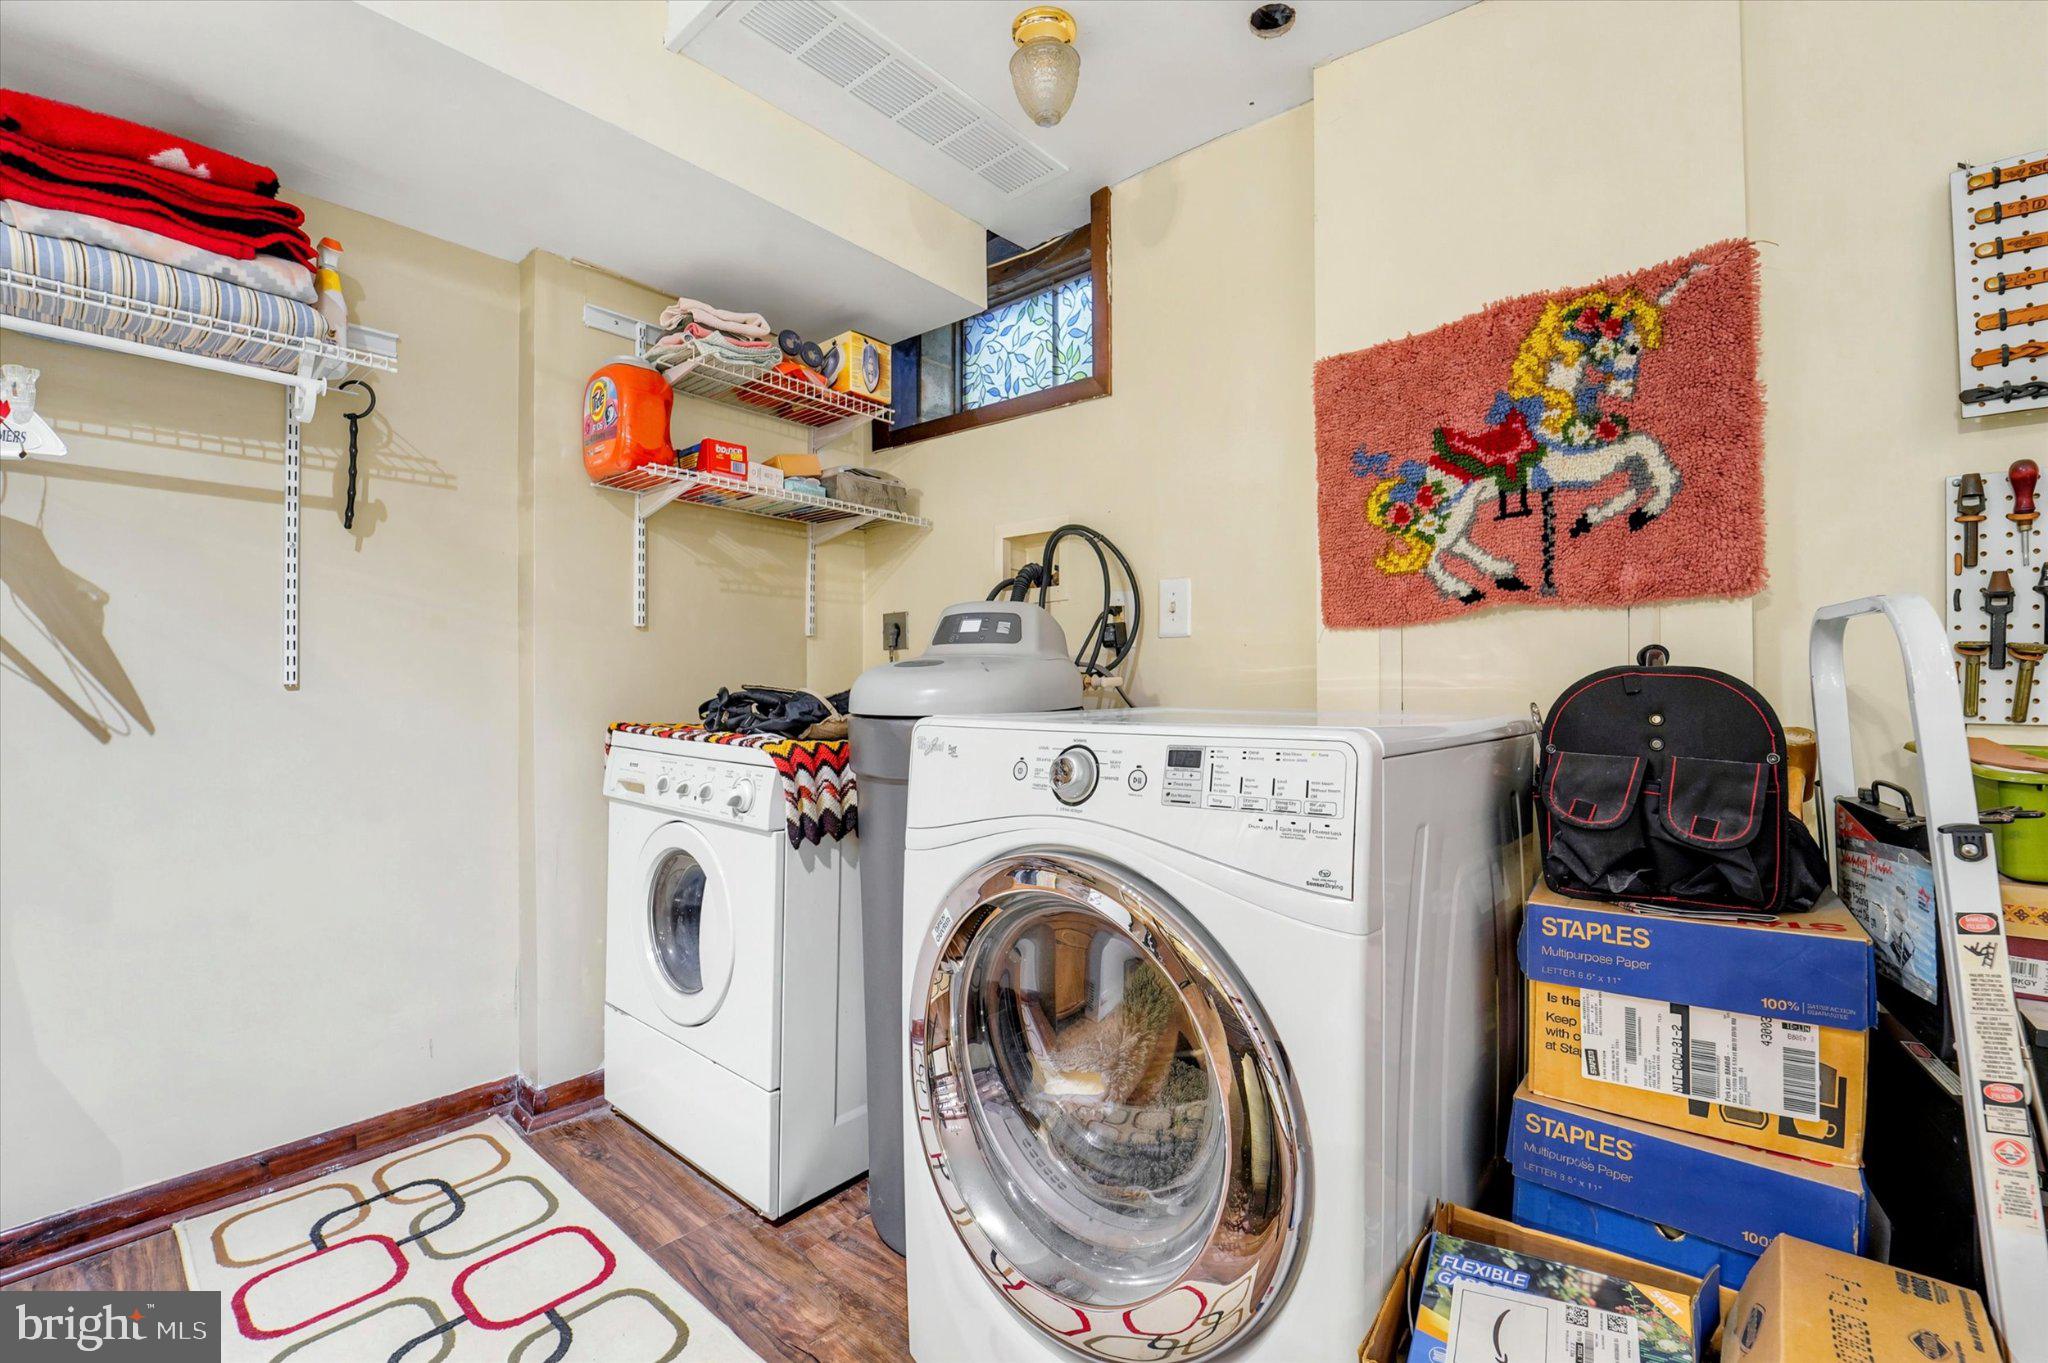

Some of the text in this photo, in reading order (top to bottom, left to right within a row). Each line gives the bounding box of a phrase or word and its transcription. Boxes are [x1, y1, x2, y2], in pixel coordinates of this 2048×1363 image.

[592, 390, 604, 412] Tide
[1541, 916, 1651, 949] STAPLES
[1541, 945, 1651, 970] Multipurpose Paper
[1541, 966, 1576, 978] LETTER
[1547, 992, 1557, 1003] Is
[1761, 997, 1800, 1012] 100%
[1546, 1011, 1577, 1027] Keep
[1545, 1027, 1569, 1039] with
[1545, 1041, 1556, 1051] at
[1525, 1113, 1633, 1161] STAPLES
[1523, 1142, 1633, 1183] Multipurpose Paper
[1523, 1162, 1558, 1178] LETTER
[1441, 1255, 1528, 1287] FLEXIBLE
